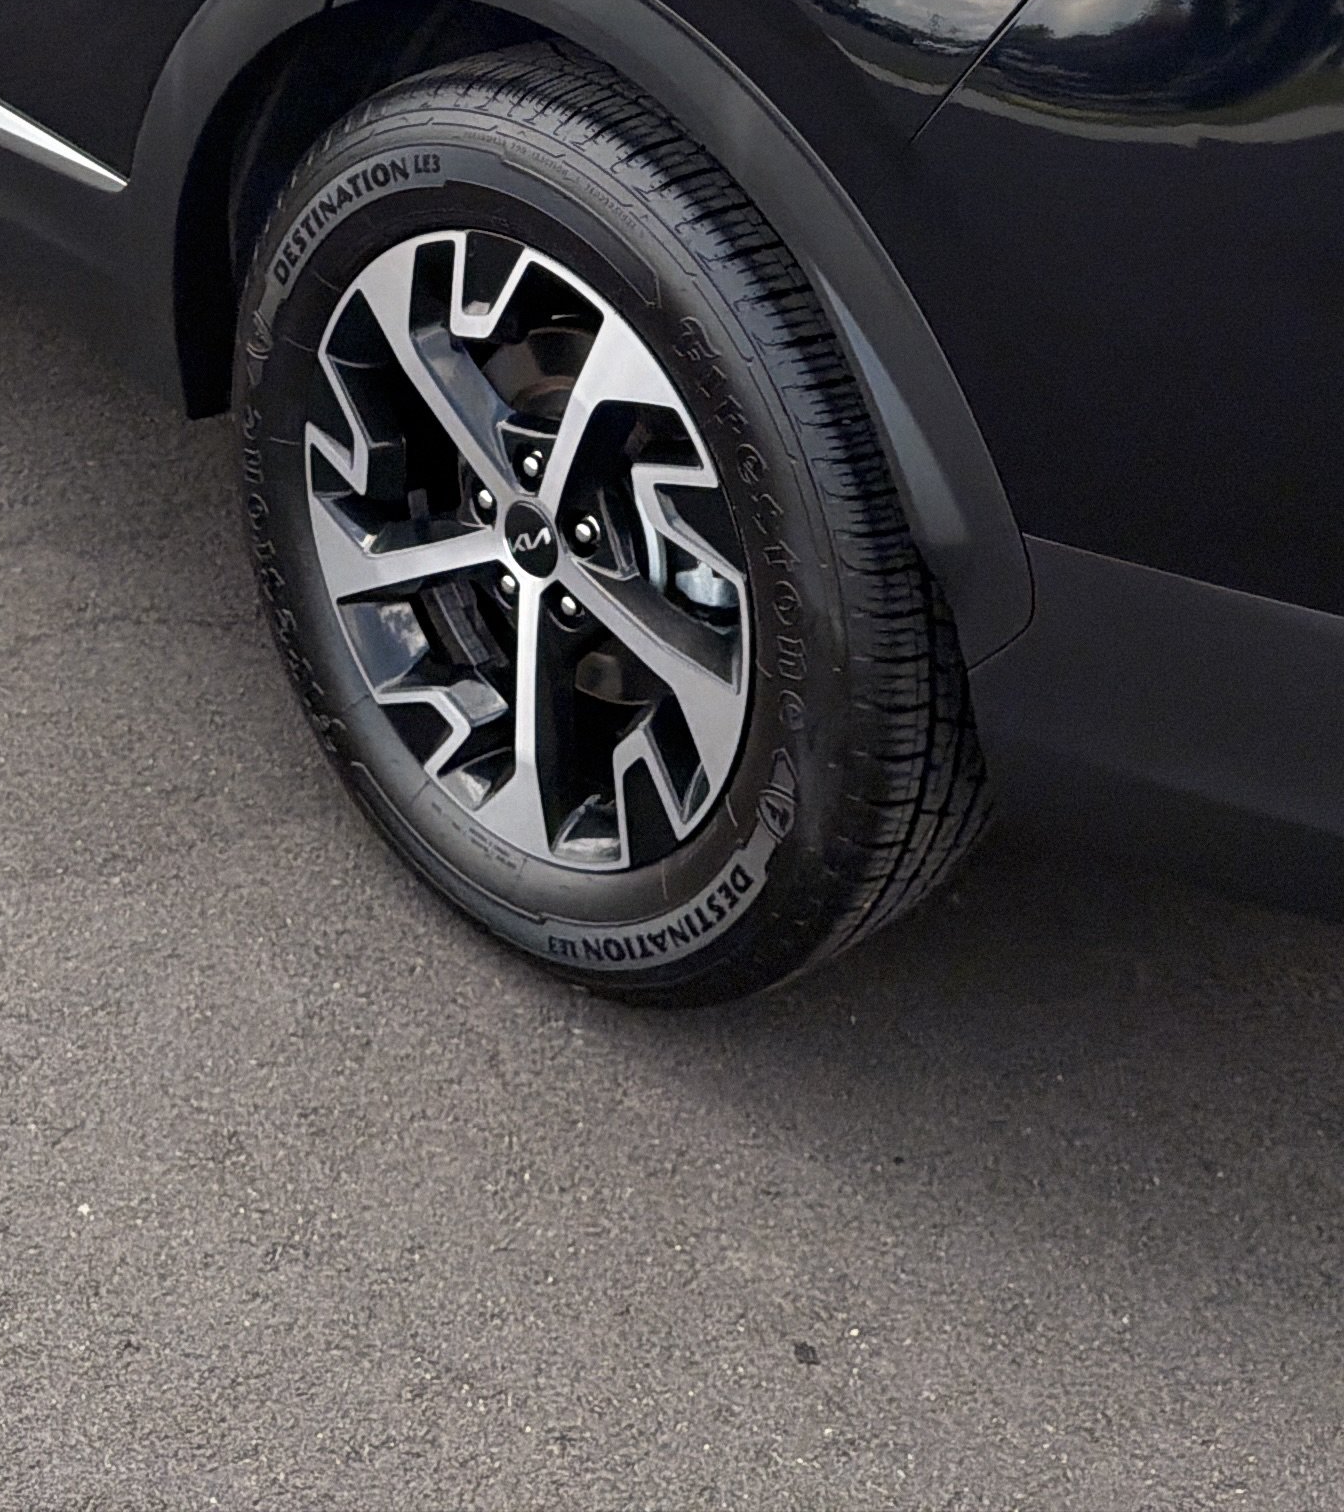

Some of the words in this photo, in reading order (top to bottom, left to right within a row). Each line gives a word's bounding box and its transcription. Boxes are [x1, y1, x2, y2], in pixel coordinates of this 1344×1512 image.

[273, 157, 410, 286] DESTINATION
[413, 153, 441, 174] LE3
[582, 863, 755, 962] DESTINATION
